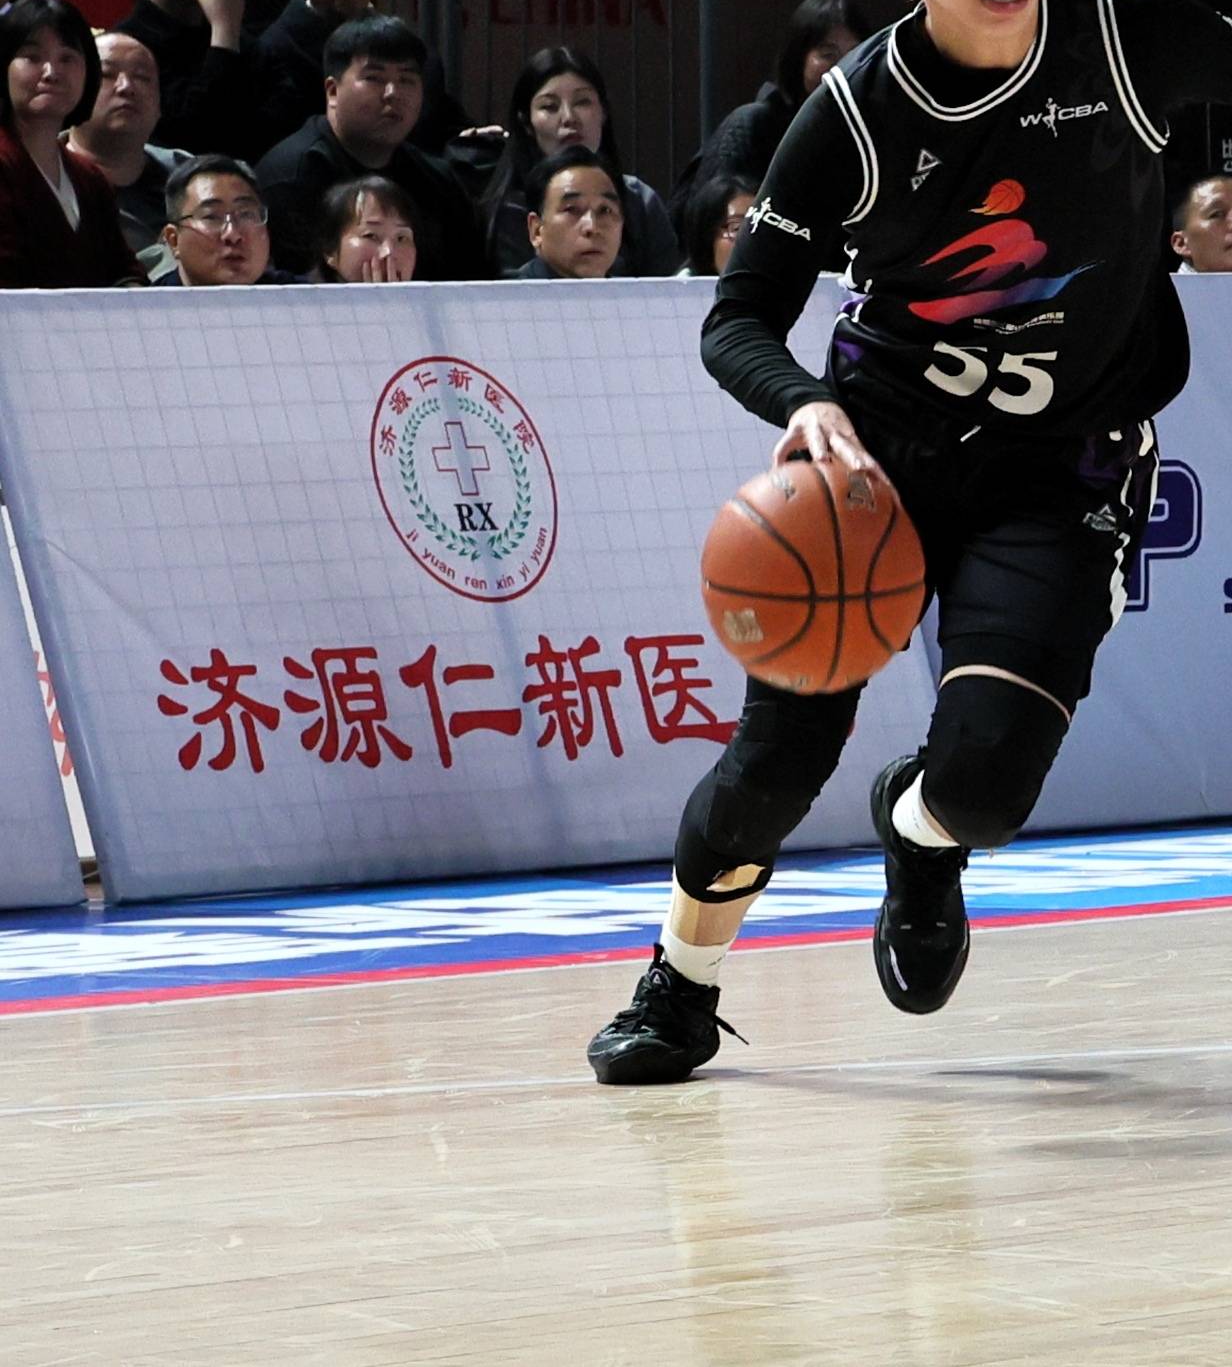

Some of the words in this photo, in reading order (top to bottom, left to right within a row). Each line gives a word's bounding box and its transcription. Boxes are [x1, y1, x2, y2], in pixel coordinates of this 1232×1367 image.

[378, 367, 535, 458] 济源仁新医院
[454, 502, 500, 532] RX
[422, 547, 456, 581] yuan
[464, 575, 488, 591] ren
[496, 574, 516, 591] xin
[530, 527, 548, 567] yuan
[156, 634, 739, 774] 济源仁新医
